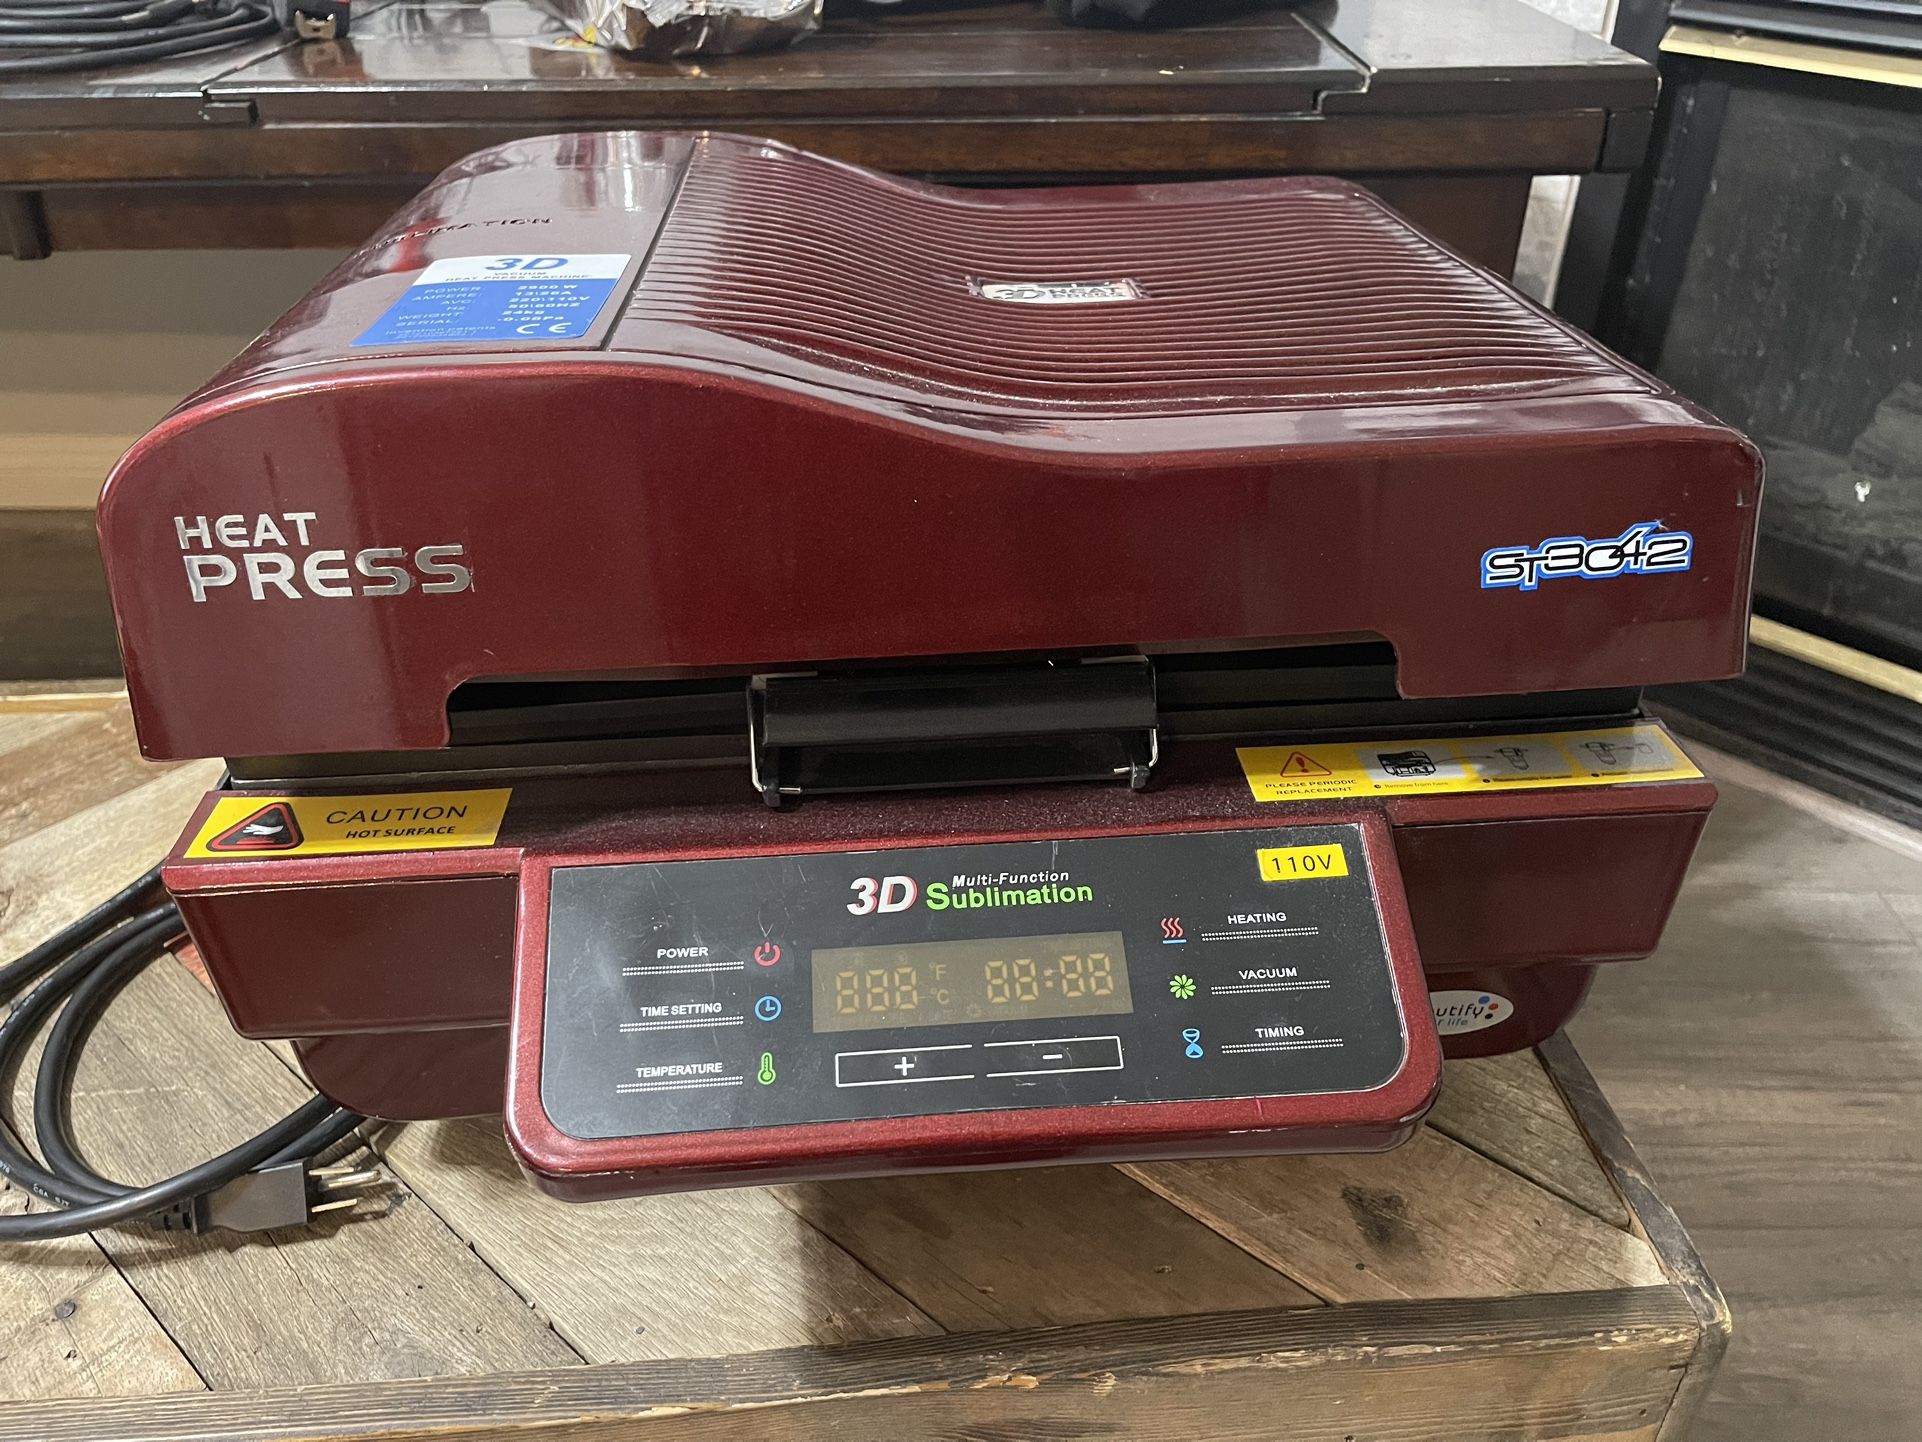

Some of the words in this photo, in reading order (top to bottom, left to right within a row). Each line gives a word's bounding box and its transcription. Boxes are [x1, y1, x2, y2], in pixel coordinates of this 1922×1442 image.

[485, 257, 569, 271] 3D
[174, 512, 318, 549] HEAT
[1486, 527, 1690, 585] ST3042
[183, 544, 472, 602] PRESS
[1276, 787, 1353, 795] REPLACEMENT
[1309, 779, 1358, 787] PERIODIC
[326, 805, 468, 825] CAUTION
[346, 828, 383, 839] HOT
[384, 825, 456, 837] SURFACE
[1271, 854, 1332, 873] 110V
[952, 870, 1069, 888] Multi-Function
[846, 875, 918, 916] 3D
[926, 882, 1093, 911] Sublimation
[1228, 912, 1287, 925] HEATING
[657, 946, 709, 959] POWER
[1238, 967, 1298, 980] VACUUM
[640, 1005, 669, 1018] TIME
[671, 1002, 722, 1016] SETTING
[1435, 1003, 1485, 1019] utify
[1254, 1026, 1305, 1038] TIMING
[636, 1062, 723, 1078] TEMPERATURE
